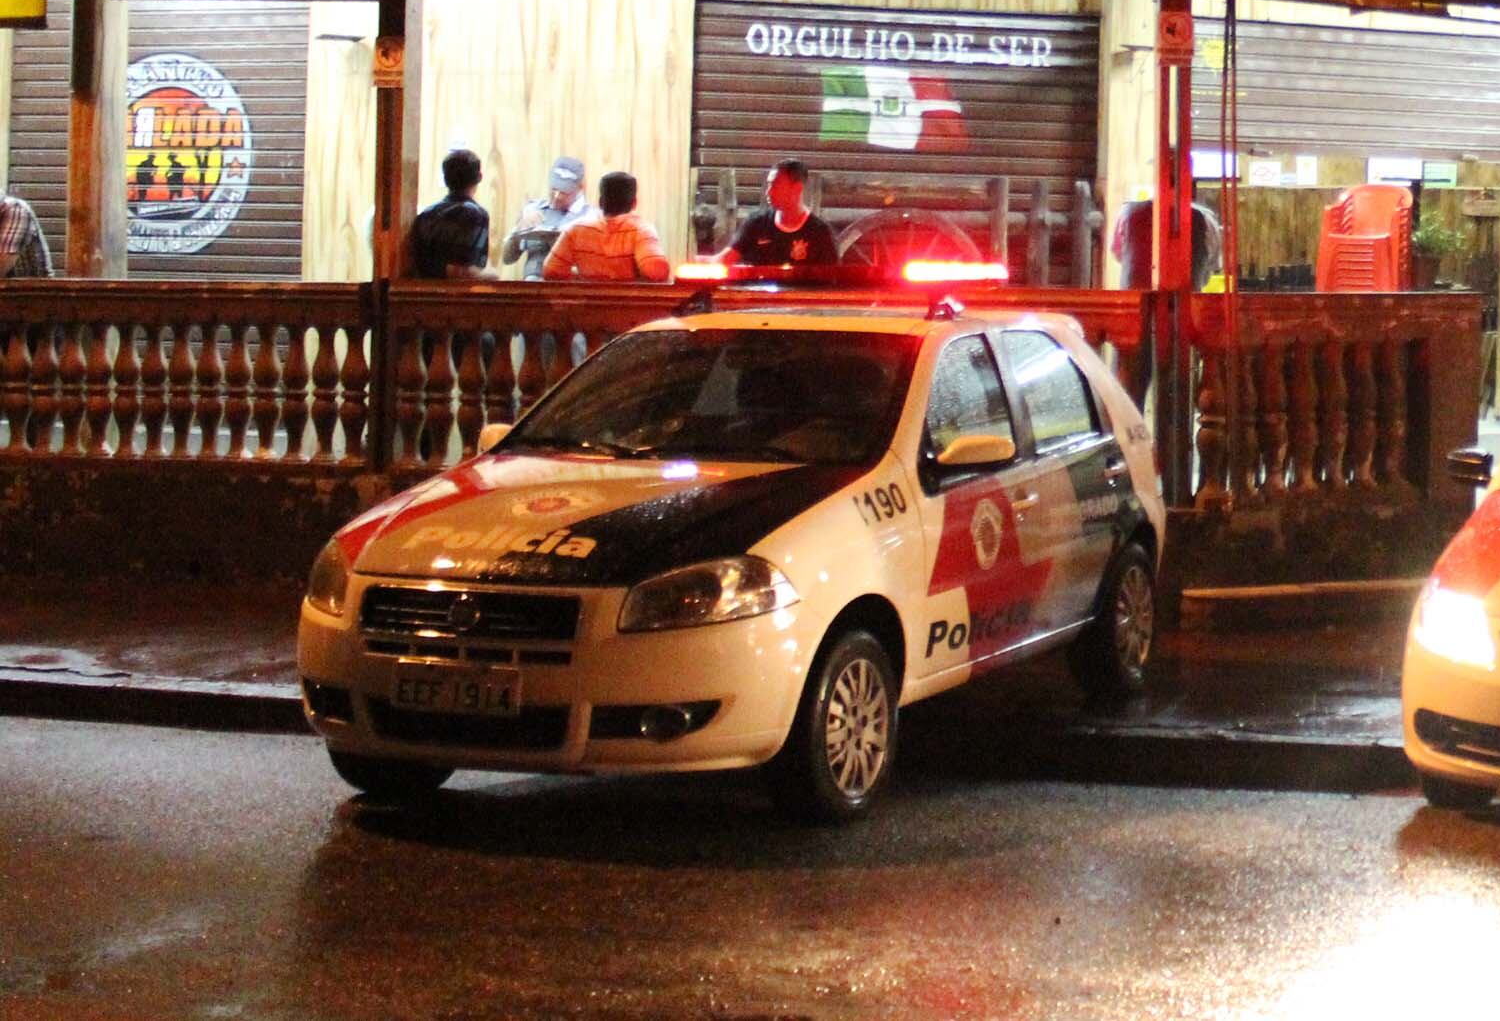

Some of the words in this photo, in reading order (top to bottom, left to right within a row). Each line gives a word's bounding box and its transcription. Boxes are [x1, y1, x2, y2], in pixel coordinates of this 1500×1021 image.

[746, 23, 915, 62] ORGULHO
[931, 32, 974, 62] DE
[988, 35, 1053, 67] SER
[864, 483, 906, 524] 190
